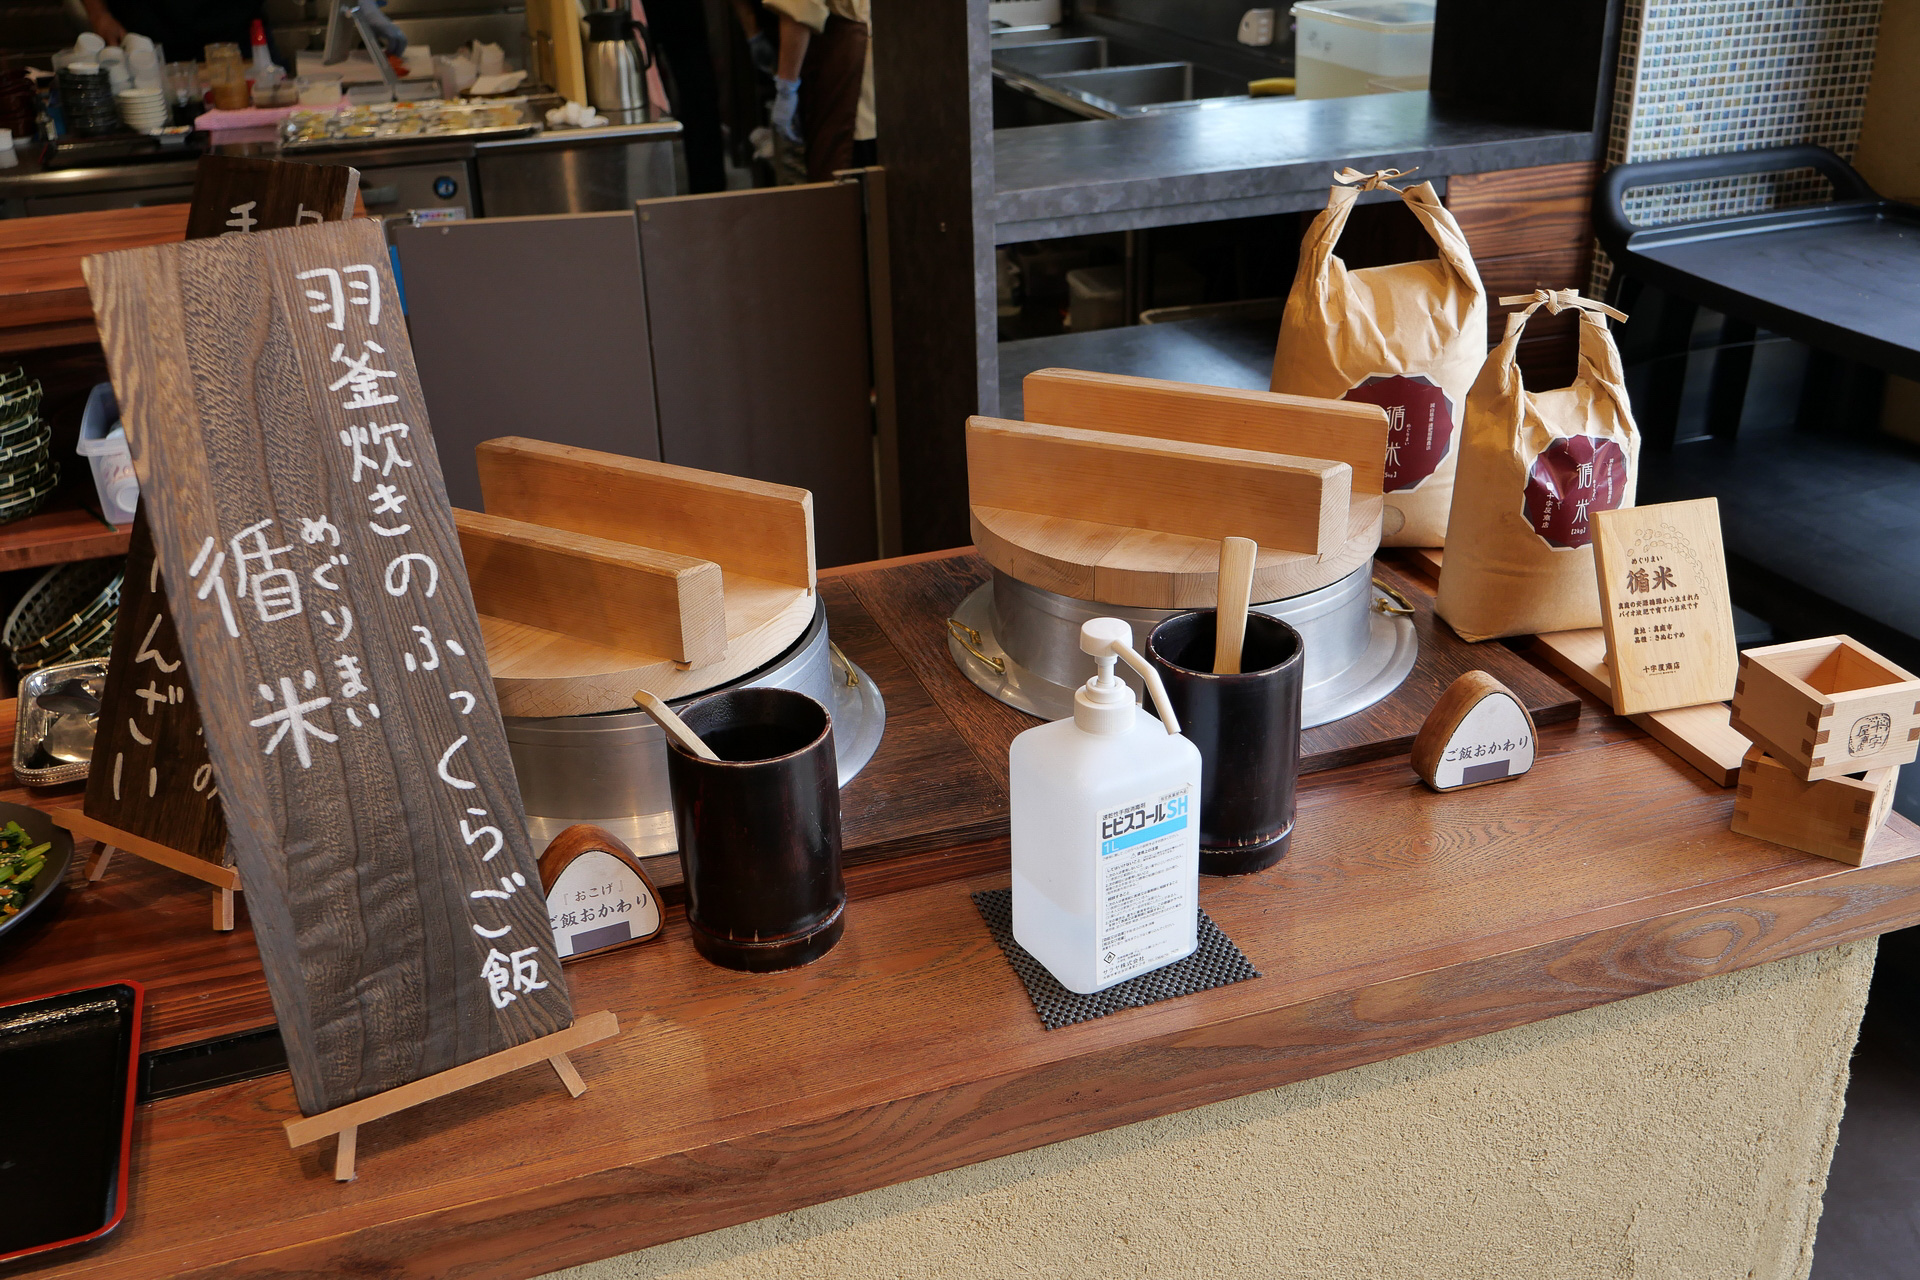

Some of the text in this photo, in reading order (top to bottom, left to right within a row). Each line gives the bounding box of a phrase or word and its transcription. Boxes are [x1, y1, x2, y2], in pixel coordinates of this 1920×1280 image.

[1571, 461, 1594, 525] 循米
[1626, 565, 1678, 595] 循米
[1631, 555, 1664, 565] めぐりまい
[187, 515, 339, 769] 循米
[294, 263, 549, 1009] 羽釜炊きのふっくらご飯
[299, 513, 382, 729] めぐりまい
[112, 555, 184, 801] んざい
[1642, 661, 1681, 674] 十字屋商店
[1445, 735, 1529, 762] ご飯おかわり
